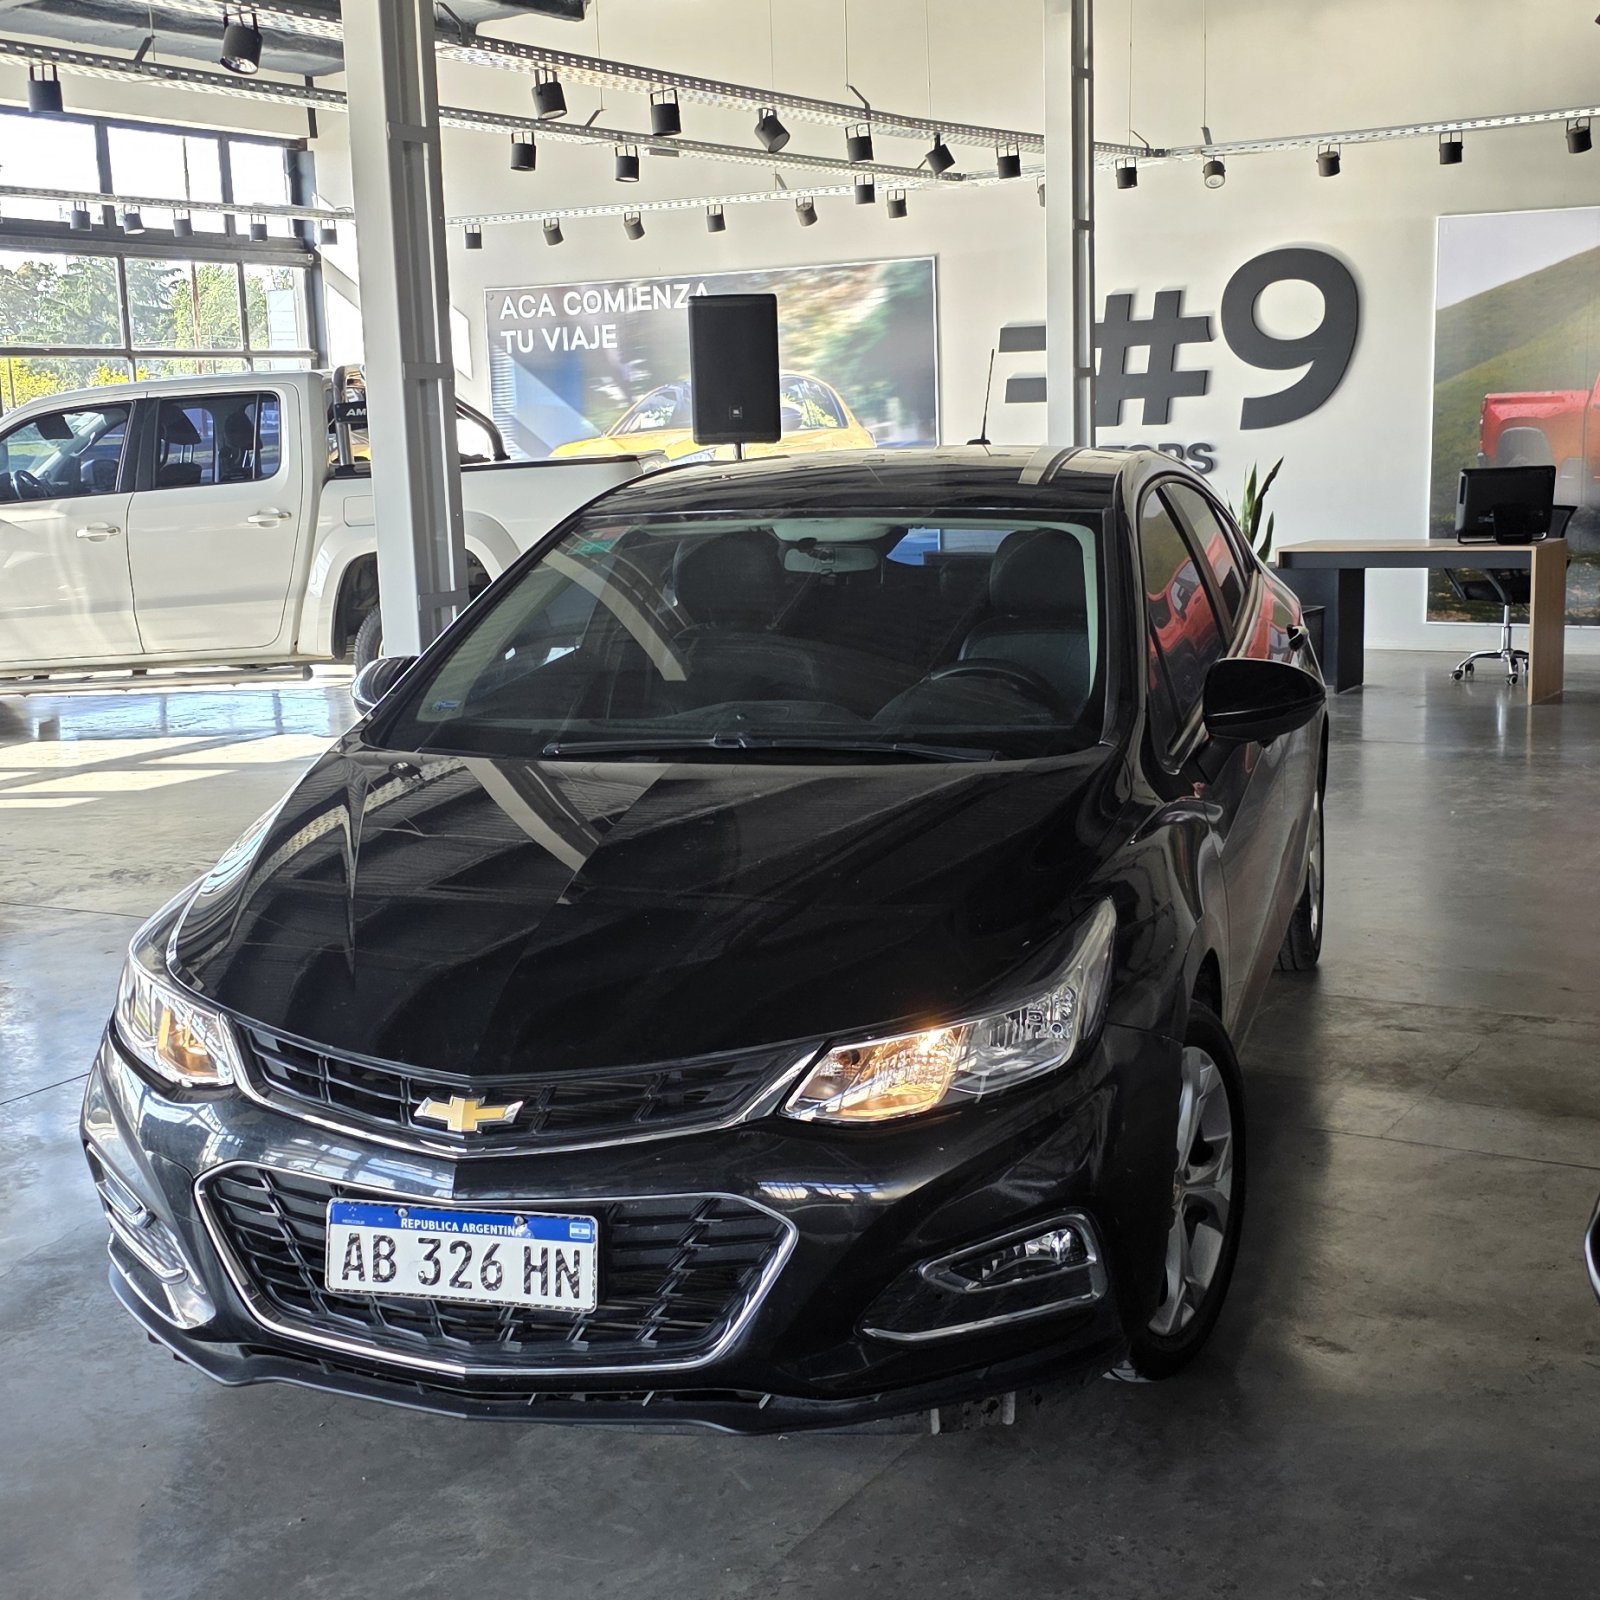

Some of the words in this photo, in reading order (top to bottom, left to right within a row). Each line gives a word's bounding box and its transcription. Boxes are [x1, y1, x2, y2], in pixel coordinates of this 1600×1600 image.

[499, 295, 556, 320] ACA
[500, 328, 534, 354] TU
[541, 324, 618, 352] VIAJE
[400, 1218, 460, 1233] REPUBLICA
[341, 1232, 397, 1284] AB
[417, 1237, 503, 1292] 326
[523, 1245, 580, 1299] HN
